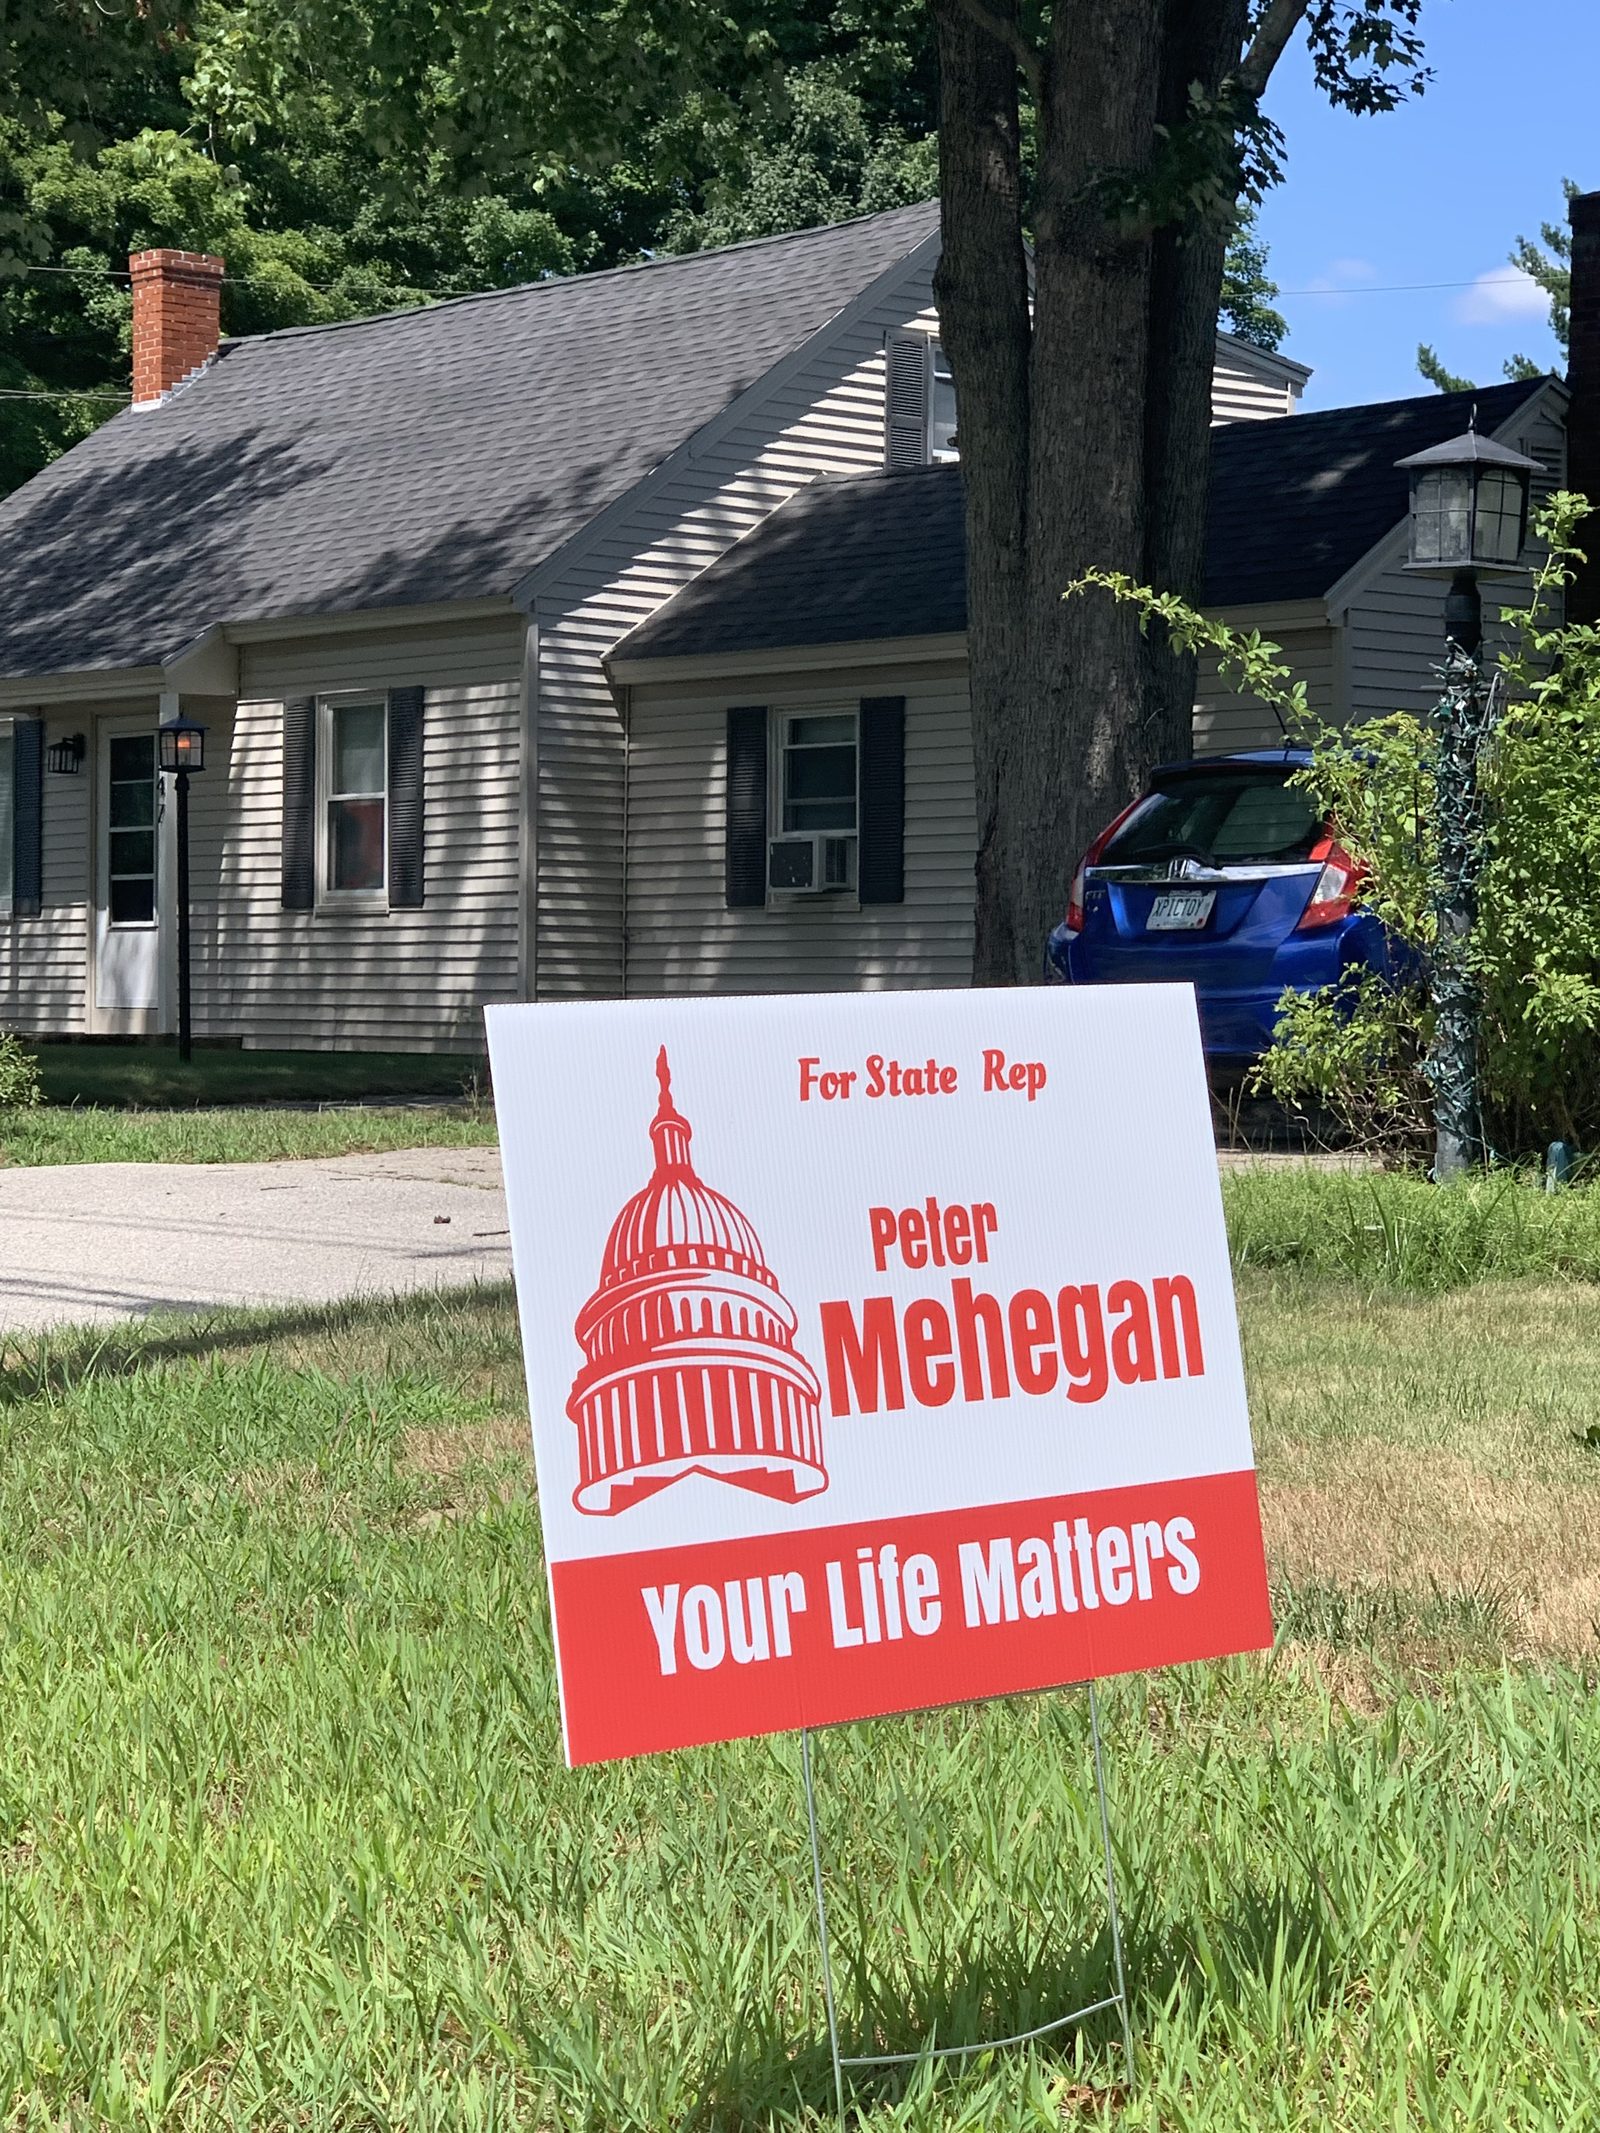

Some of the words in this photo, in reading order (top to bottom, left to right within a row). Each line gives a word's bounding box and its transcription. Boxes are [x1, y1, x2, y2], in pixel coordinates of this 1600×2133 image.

[799, 1056, 858, 1101] For
[865, 1054, 958, 1098] State
[983, 1048, 1047, 1101] Rep
[869, 1196, 999, 1273] Peter
[819, 1274, 1205, 1417] Mehegan
[641, 1571, 807, 1676] Your
[825, 1543, 942, 1649] Life
[958, 1516, 1201, 1628] Matters
